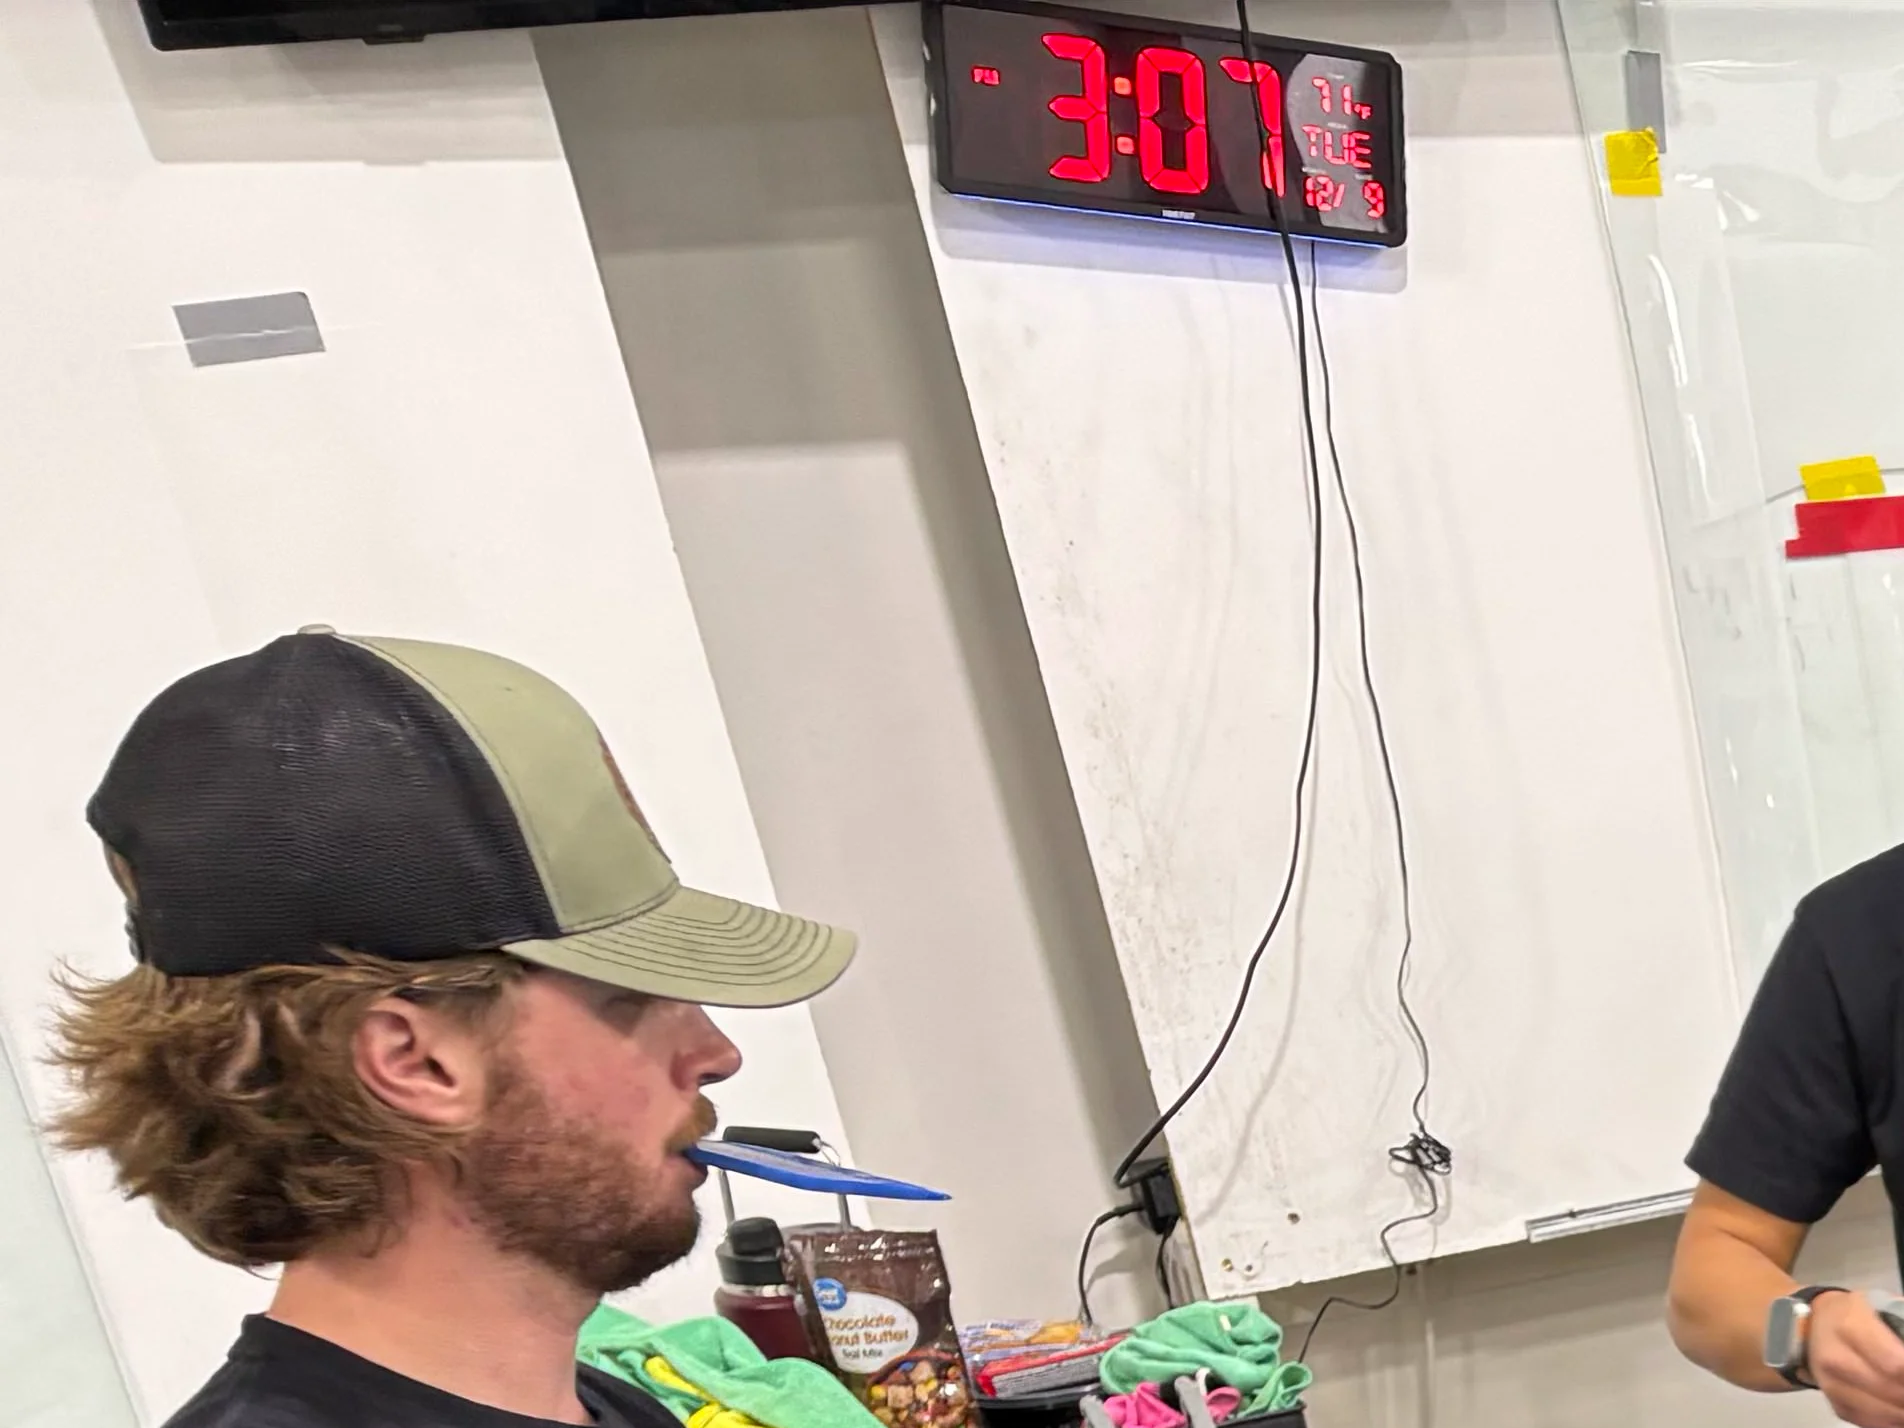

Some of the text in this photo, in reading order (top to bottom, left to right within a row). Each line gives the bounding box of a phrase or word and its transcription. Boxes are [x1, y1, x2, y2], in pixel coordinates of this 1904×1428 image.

[1041, 32, 1285, 199] 3:07
[1302, 124, 1372, 169] TUE
[1363, 180, 1384, 218] 9
